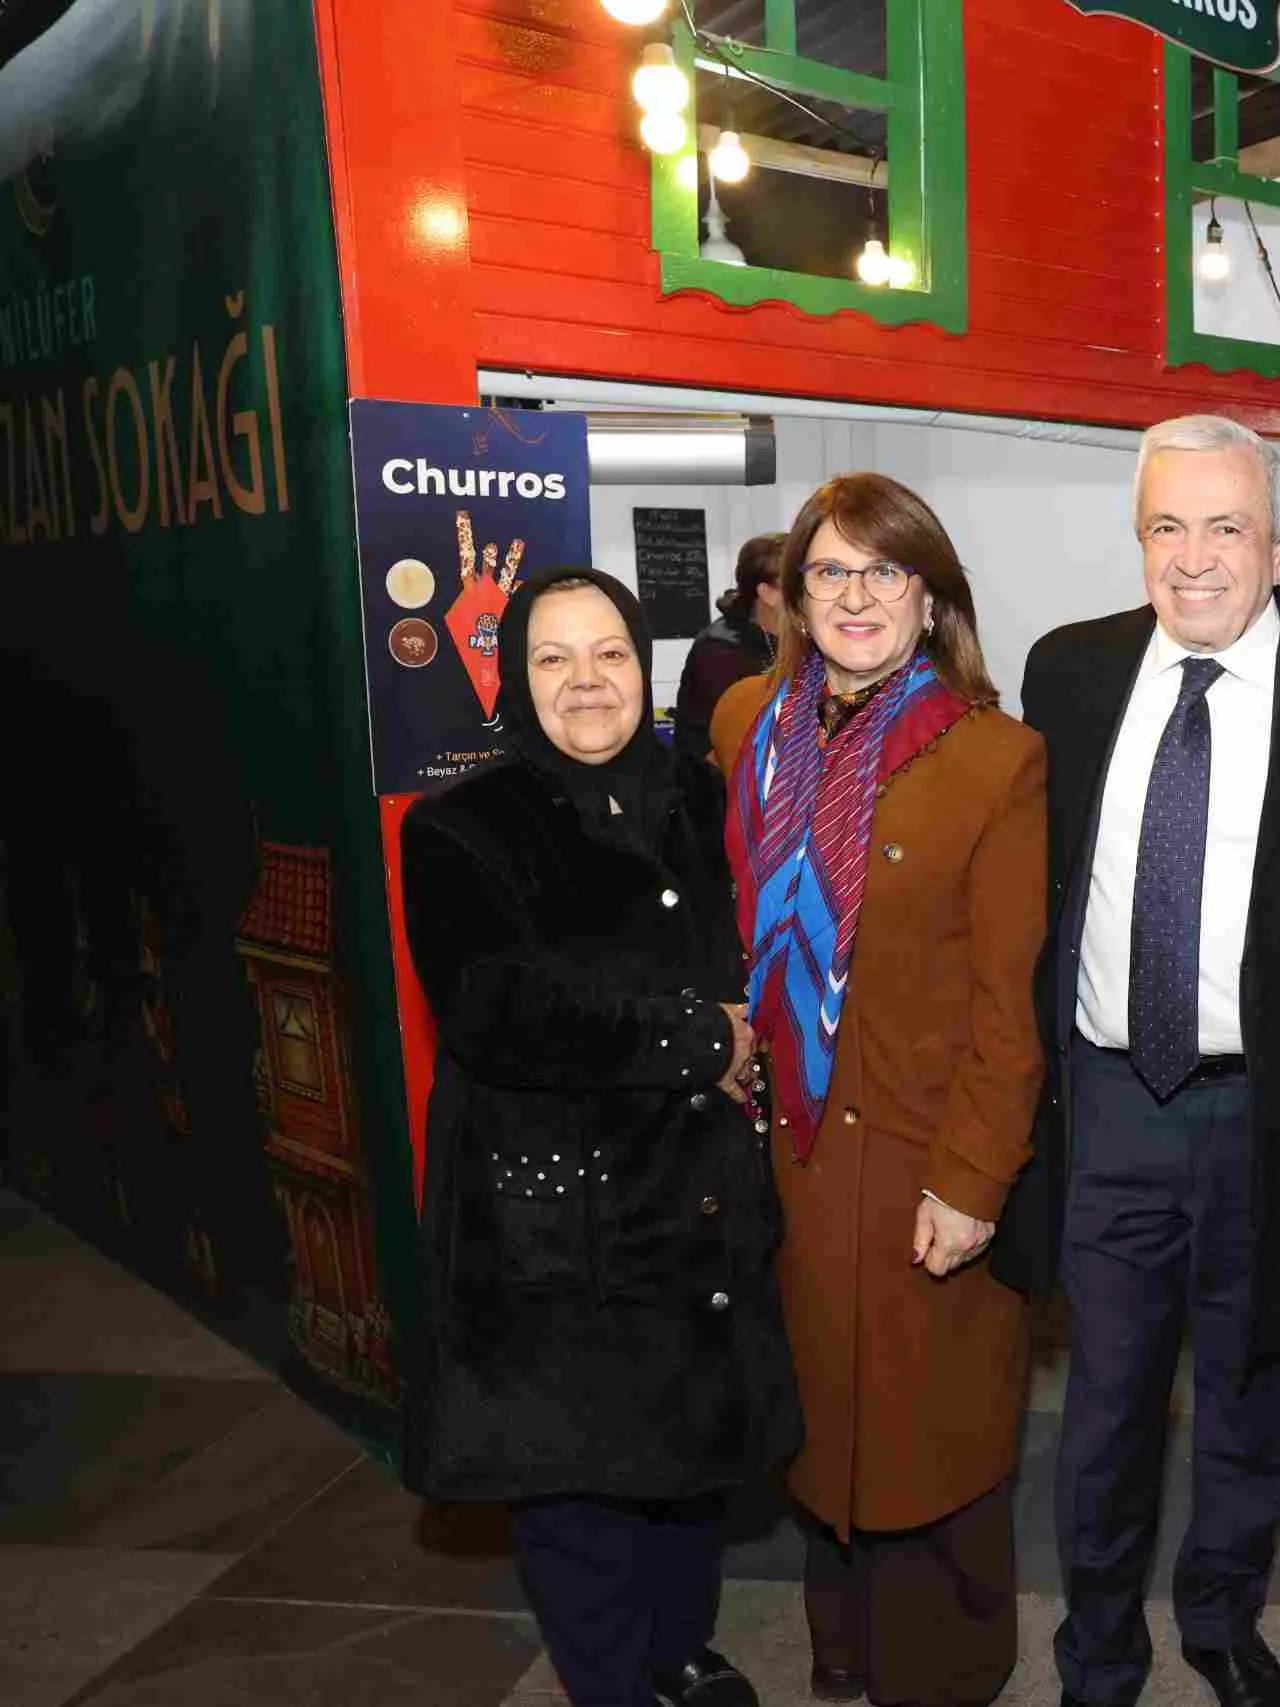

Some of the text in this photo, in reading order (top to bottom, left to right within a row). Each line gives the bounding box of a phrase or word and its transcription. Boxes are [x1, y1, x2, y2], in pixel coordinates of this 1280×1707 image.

[0, 290, 290, 545] ZAN SOKAĞI
[382, 458, 566, 499] Churros
[426, 765, 457, 778] Beyaz
